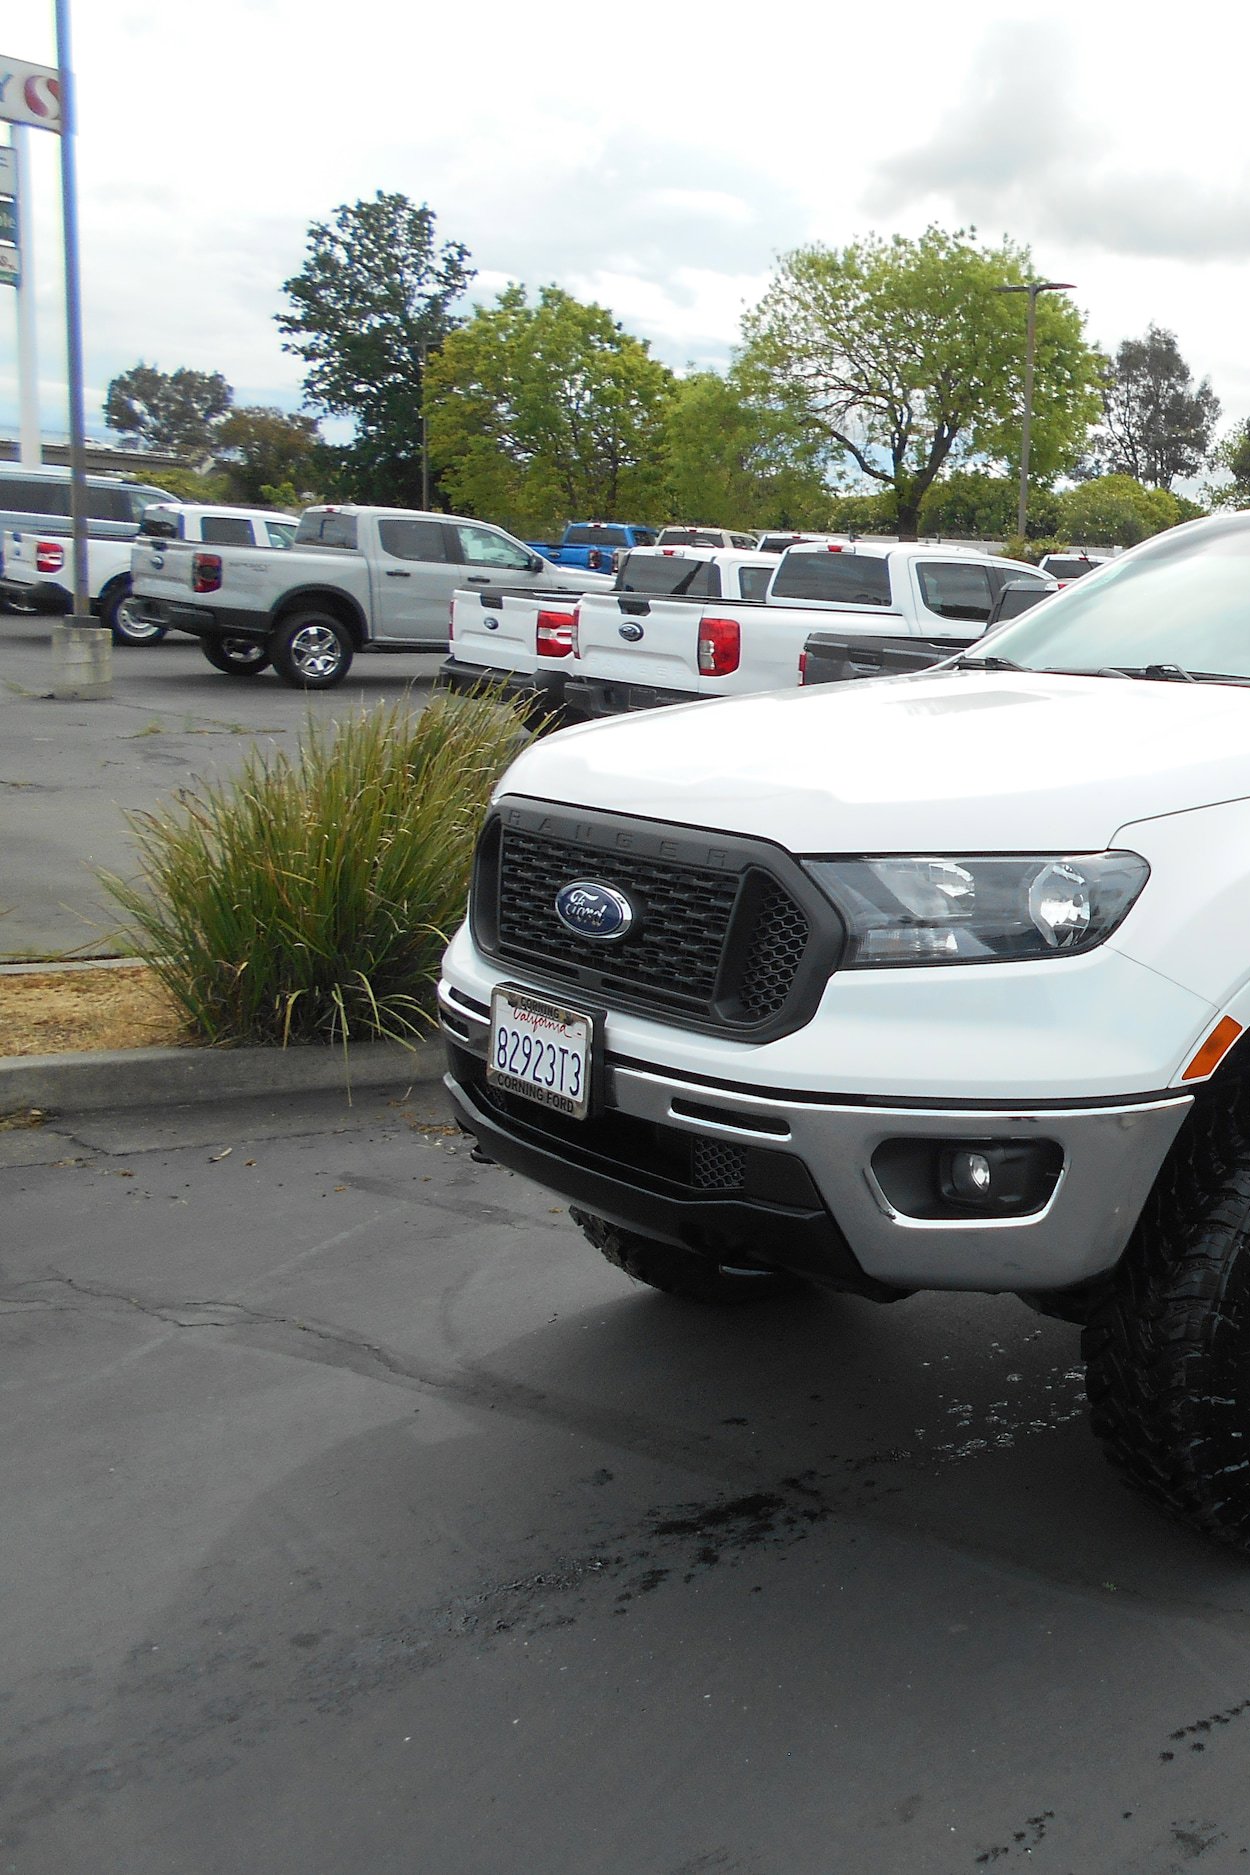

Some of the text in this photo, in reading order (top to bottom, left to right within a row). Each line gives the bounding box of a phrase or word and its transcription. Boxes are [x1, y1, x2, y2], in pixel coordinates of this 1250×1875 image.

[507, 809, 729, 867] RANGER
[564, 889, 608, 927] Ford
[513, 1006, 573, 1039] California
[520, 996, 560, 1019] CORNING
[497, 1026, 581, 1096] 82923T3
[497, 1073, 574, 1113] CORNING FORD
